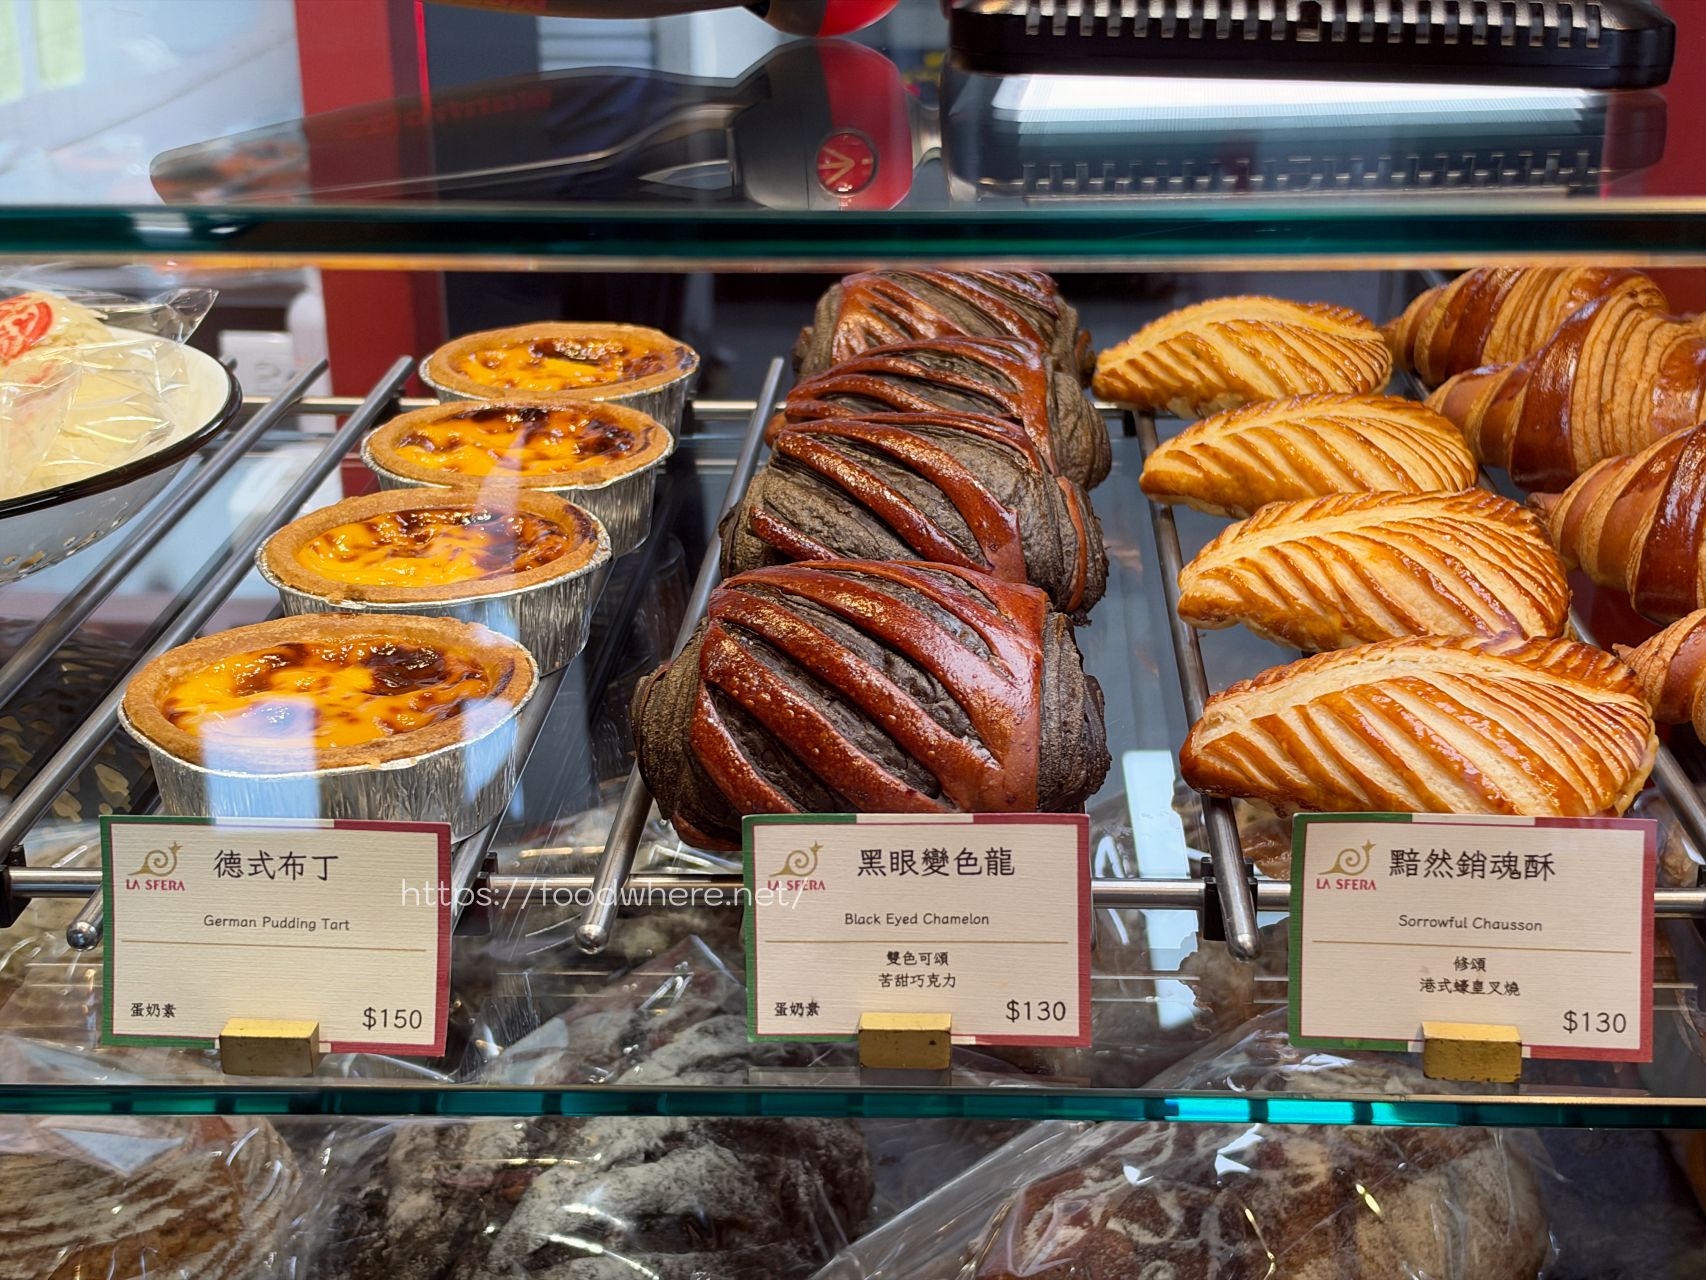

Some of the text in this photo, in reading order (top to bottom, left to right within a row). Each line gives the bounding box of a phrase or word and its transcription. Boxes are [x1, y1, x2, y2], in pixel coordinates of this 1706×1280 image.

[213, 850, 339, 881] 德式布丁
[857, 847, 1016, 877] 黑眼變色龍
[1389, 848, 1556, 881] 黯然銷魂酥
[126, 880, 186, 892] LA SFERA
[786, 880, 826, 891] SFERA
[1316, 878, 1377, 891] LA SFERA
[203, 915, 350, 932] German Pudding Tart
[844, 912, 990, 927] Black Eyed Chamelon
[1399, 915, 1543, 932] Sorrowful Chausson
[886, 951, 949, 967] 雙色可頌
[878, 973, 956, 989] 苦甜巧克力
[130, 1003, 176, 1018] 蛋奶素
[774, 1001, 820, 1017] 蛋奶素
[1006, 1000, 1067, 1023] $130
[362, 1006, 423, 1031] $150
[1562, 1009, 1627, 1034] $130
